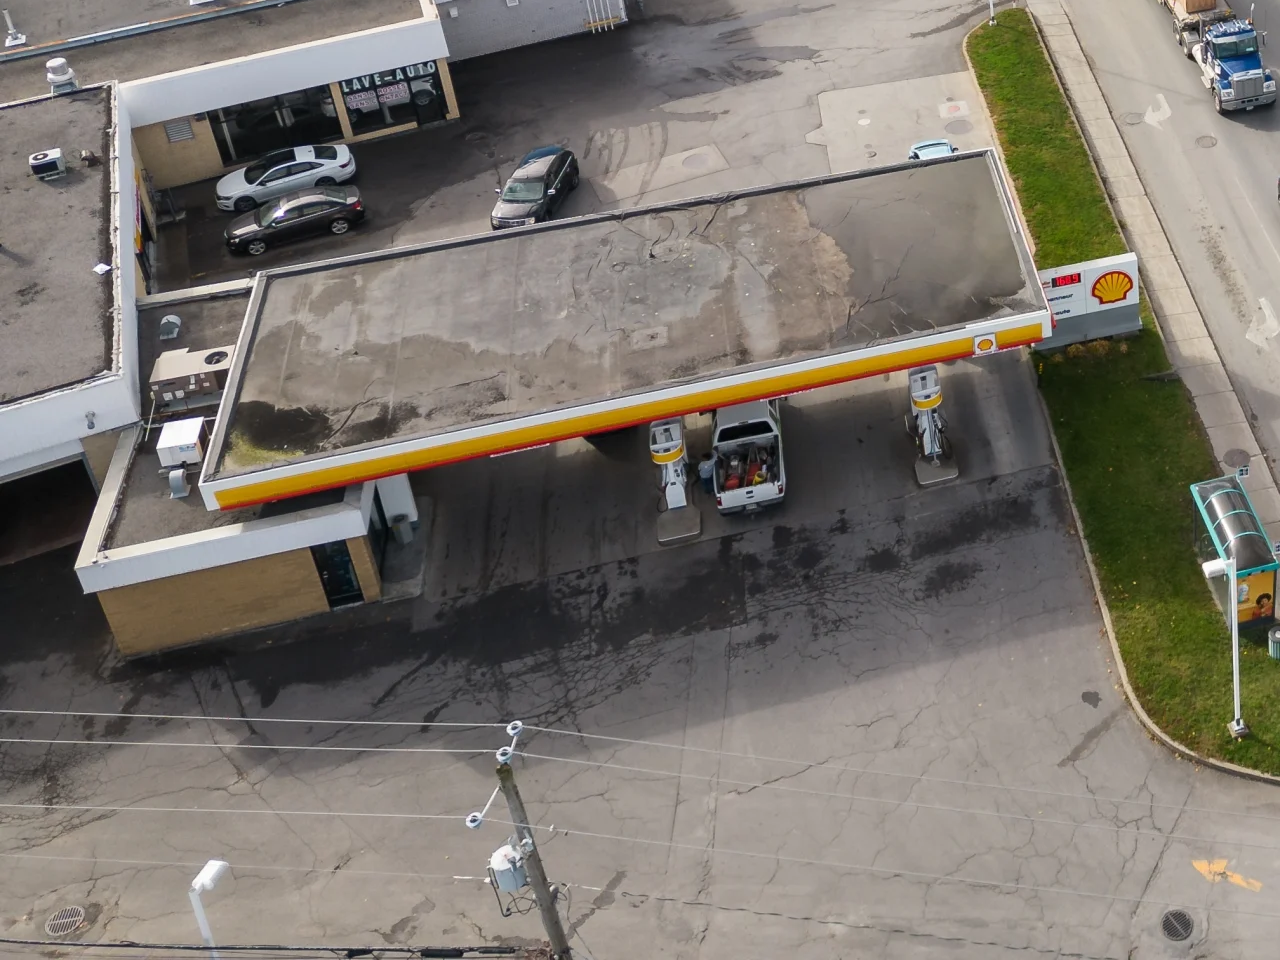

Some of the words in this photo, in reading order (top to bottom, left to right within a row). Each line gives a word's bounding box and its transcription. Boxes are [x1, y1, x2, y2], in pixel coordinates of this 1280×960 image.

[341, 61, 436, 93] LAVE-AUTO
[347, 92, 368, 101] SANS
[349, 100, 370, 110] SANS
